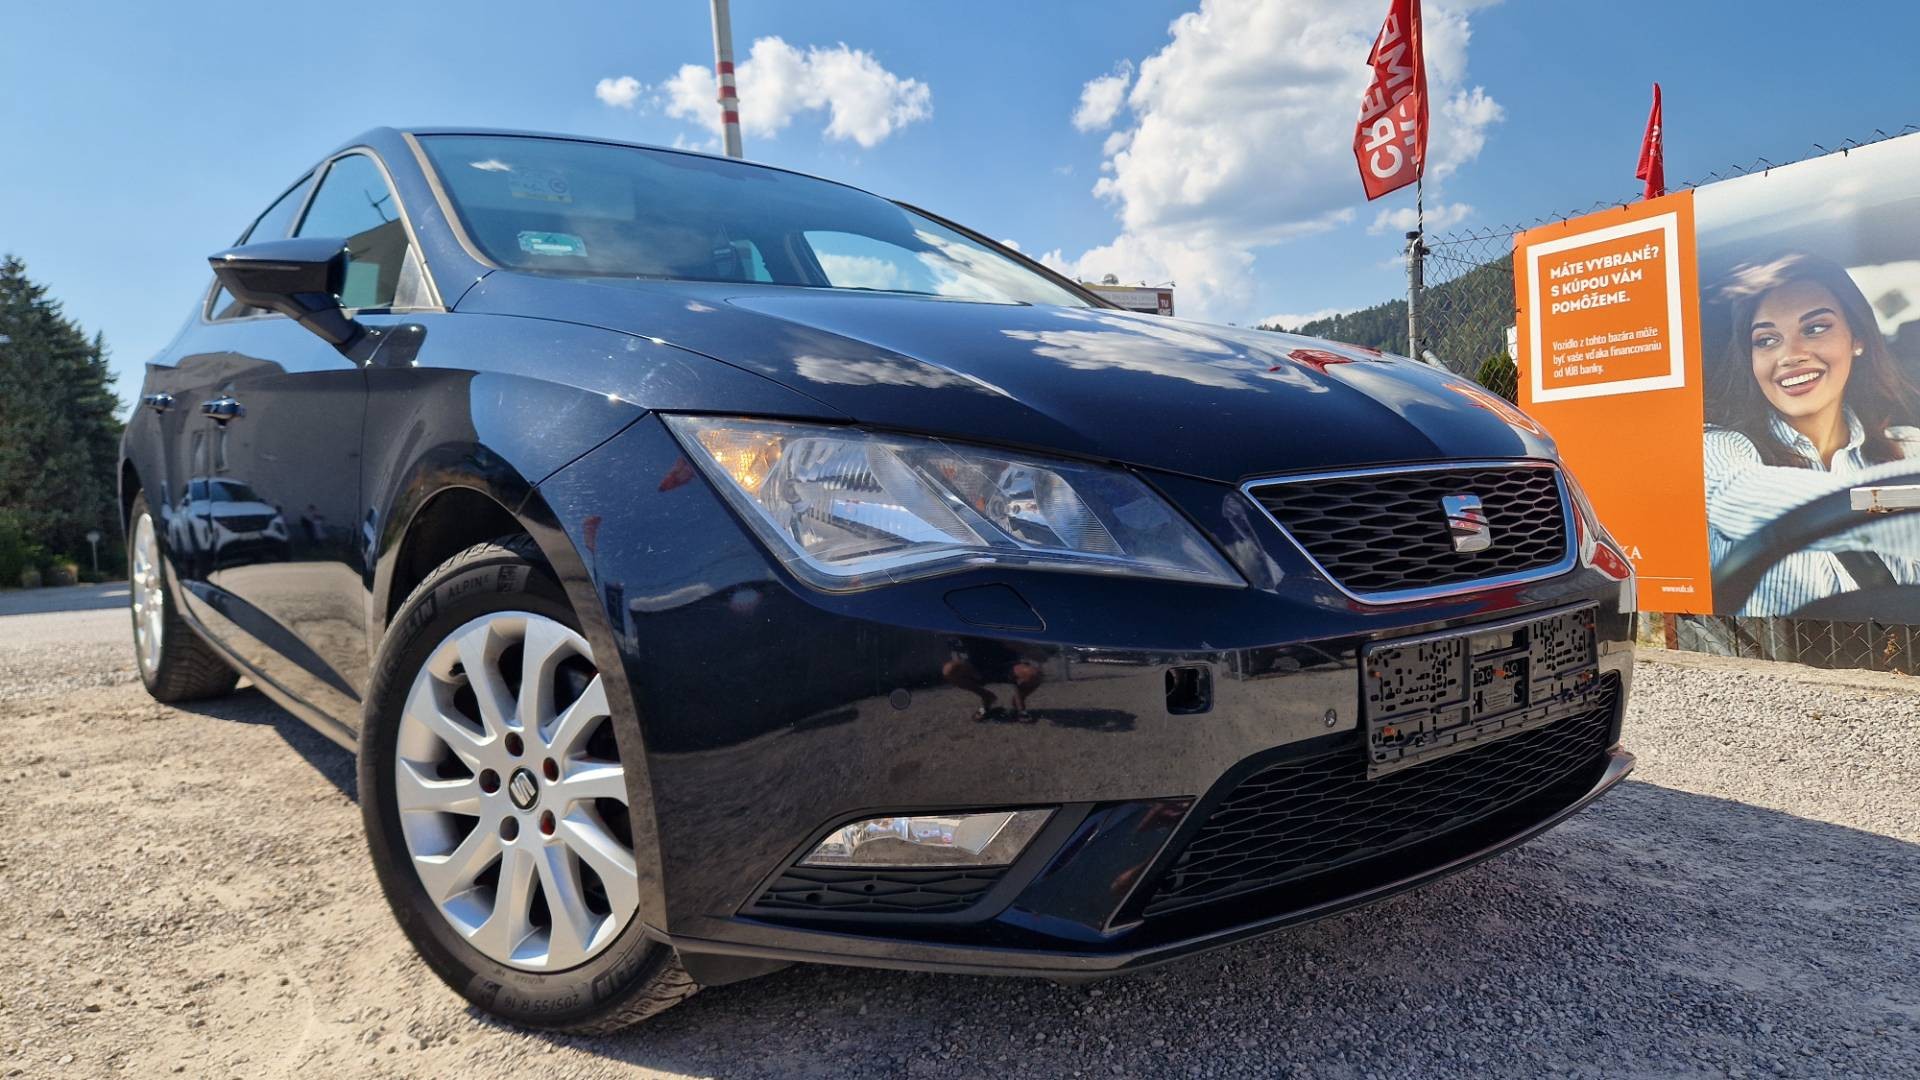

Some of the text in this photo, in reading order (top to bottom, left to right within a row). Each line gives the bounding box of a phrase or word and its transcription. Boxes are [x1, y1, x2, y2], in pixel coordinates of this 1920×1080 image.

[1551, 244, 1660, 279] MÁTE VYBRANÉ?
[1551, 268, 1643, 297] S KÚPOU VÁM
[1552, 290, 1631, 315] POMÔŽEME.
[1552, 327, 1658, 351] Vozidlo z tohto bazára môže
[1567, 352, 1583, 363] vaše
[1585, 348, 1609, 360] vďaka
[1610, 340, 1662, 356] financovaniu
[1553, 369, 1564, 378] od
